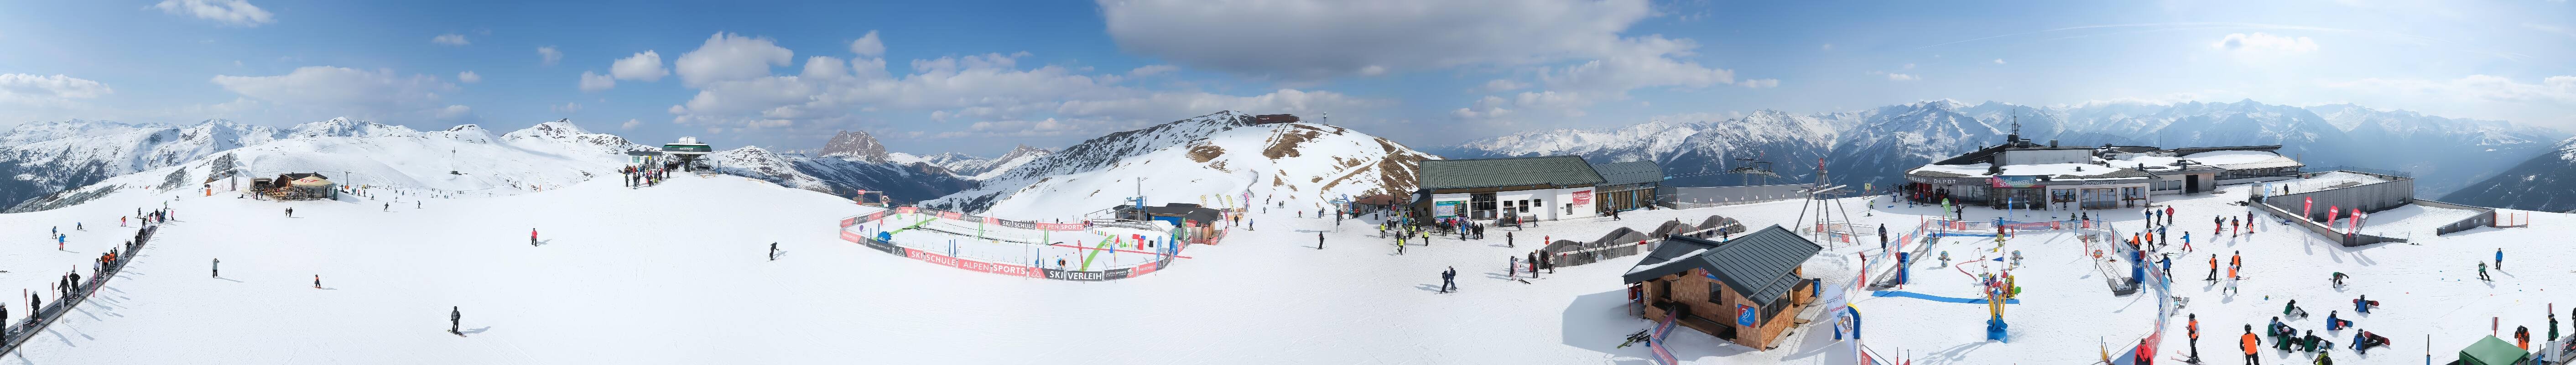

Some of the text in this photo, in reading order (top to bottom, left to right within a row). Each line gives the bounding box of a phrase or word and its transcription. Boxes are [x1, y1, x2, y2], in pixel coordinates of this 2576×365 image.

[926, 254, 956, 266] SCHULE
[963, 262, 1025, 274] ALPEN SPORTS
[1050, 271, 1102, 280] SKI VERLEIH
